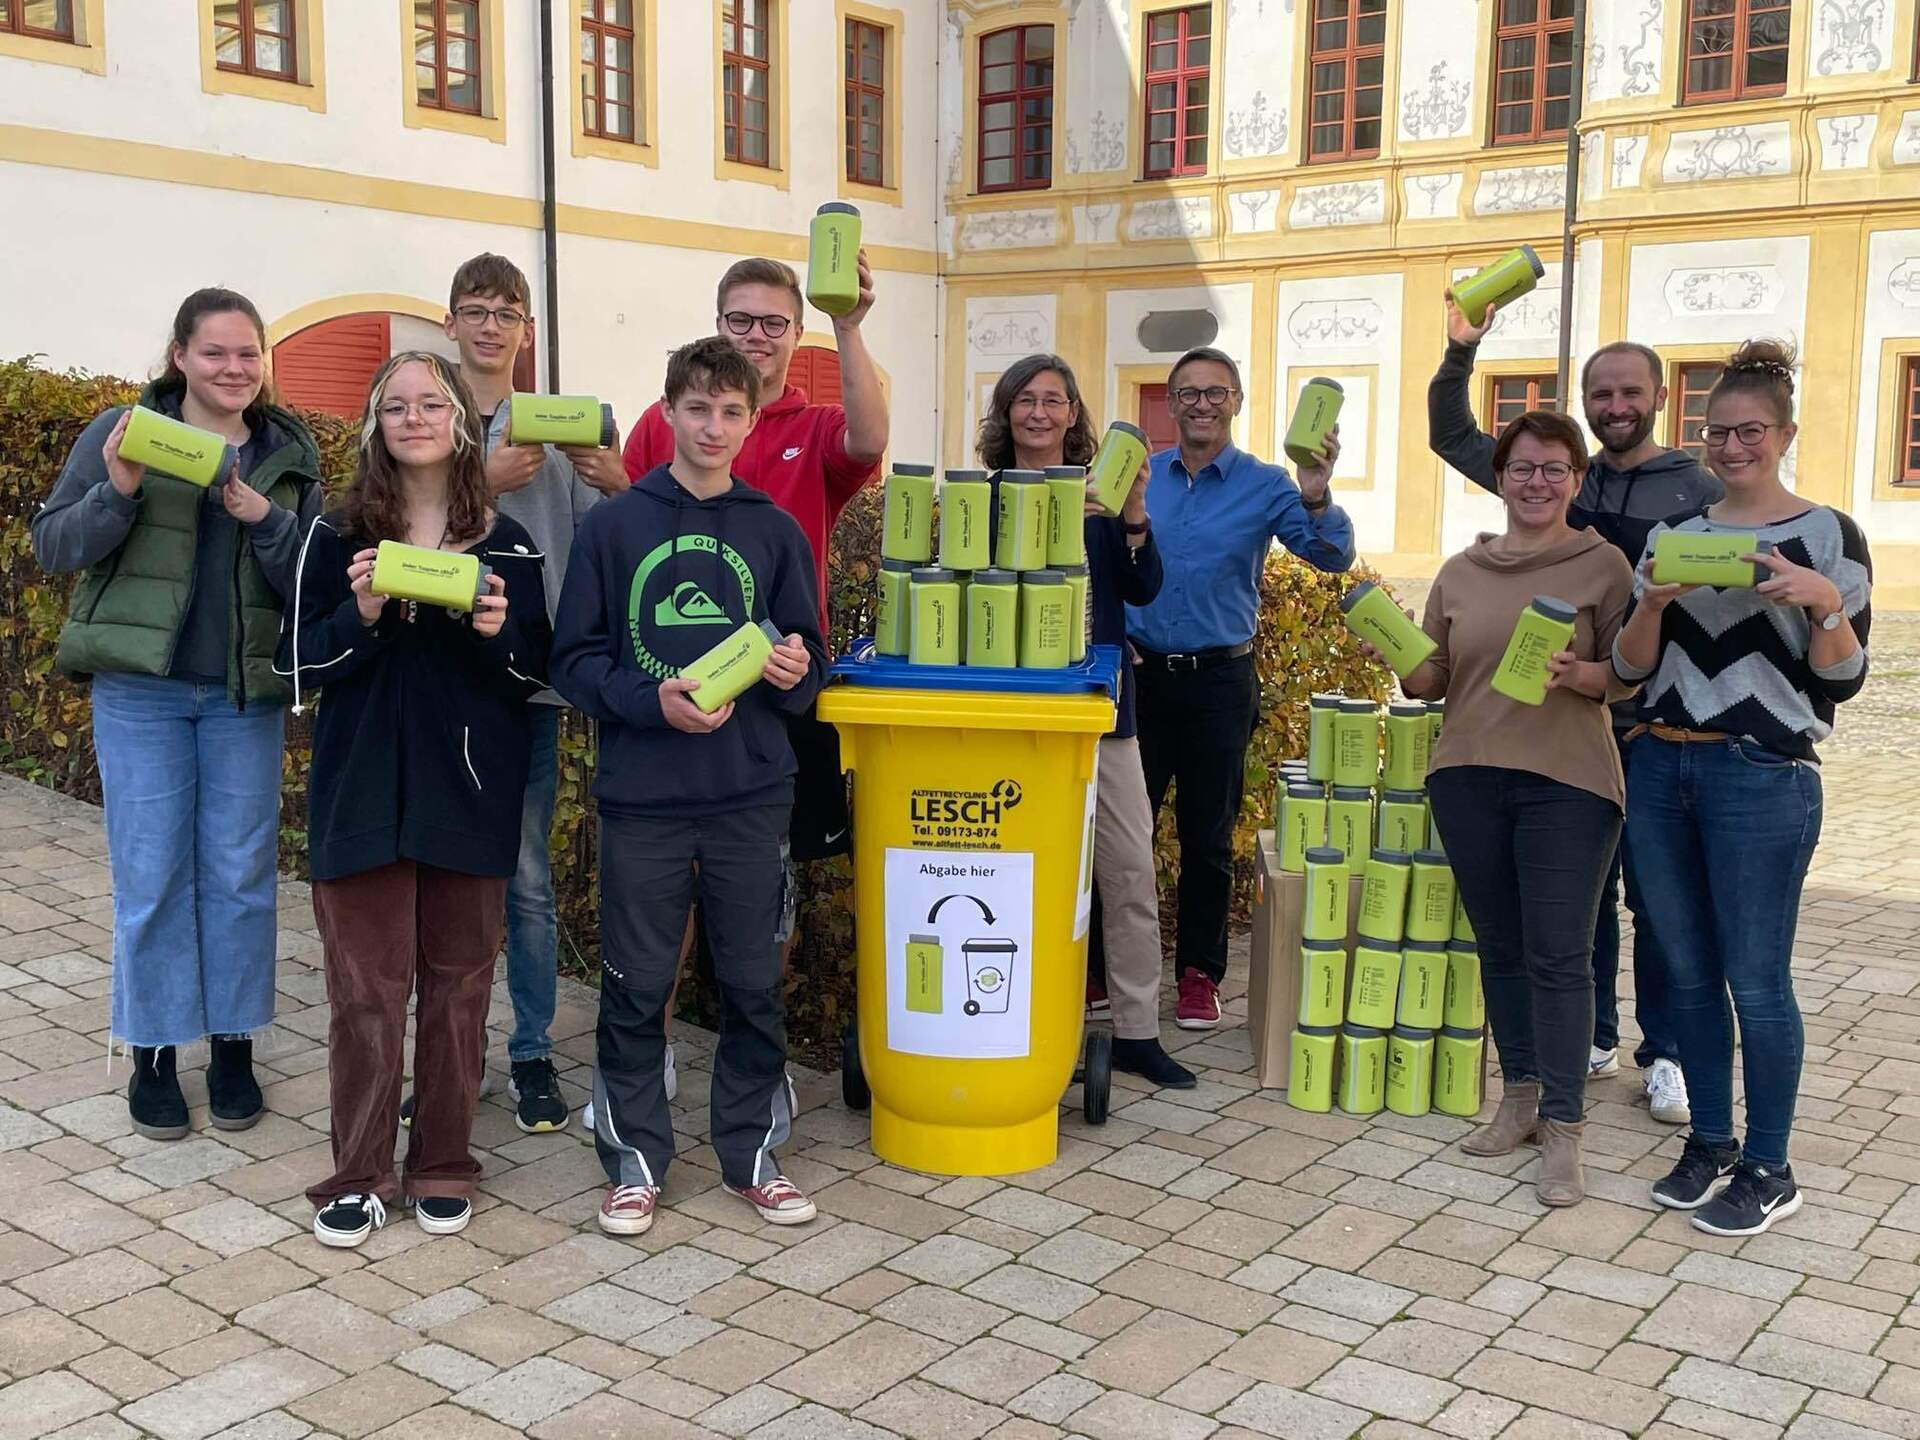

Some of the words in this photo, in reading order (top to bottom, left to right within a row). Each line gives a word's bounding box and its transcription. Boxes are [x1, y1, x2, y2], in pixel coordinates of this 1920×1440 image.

[694, 537, 754, 602] QUKSILVER
[911, 789, 987, 799] ALTFETTRECYCLING
[911, 798, 1000, 824] LESCH
[912, 824, 933, 836] Tel.
[937, 826, 998, 838] 09173-874
[912, 839, 1002, 849] www.altfett-lesch.de
[920, 863, 967, 877] Abgabe
[970, 866, 996, 877] hier
